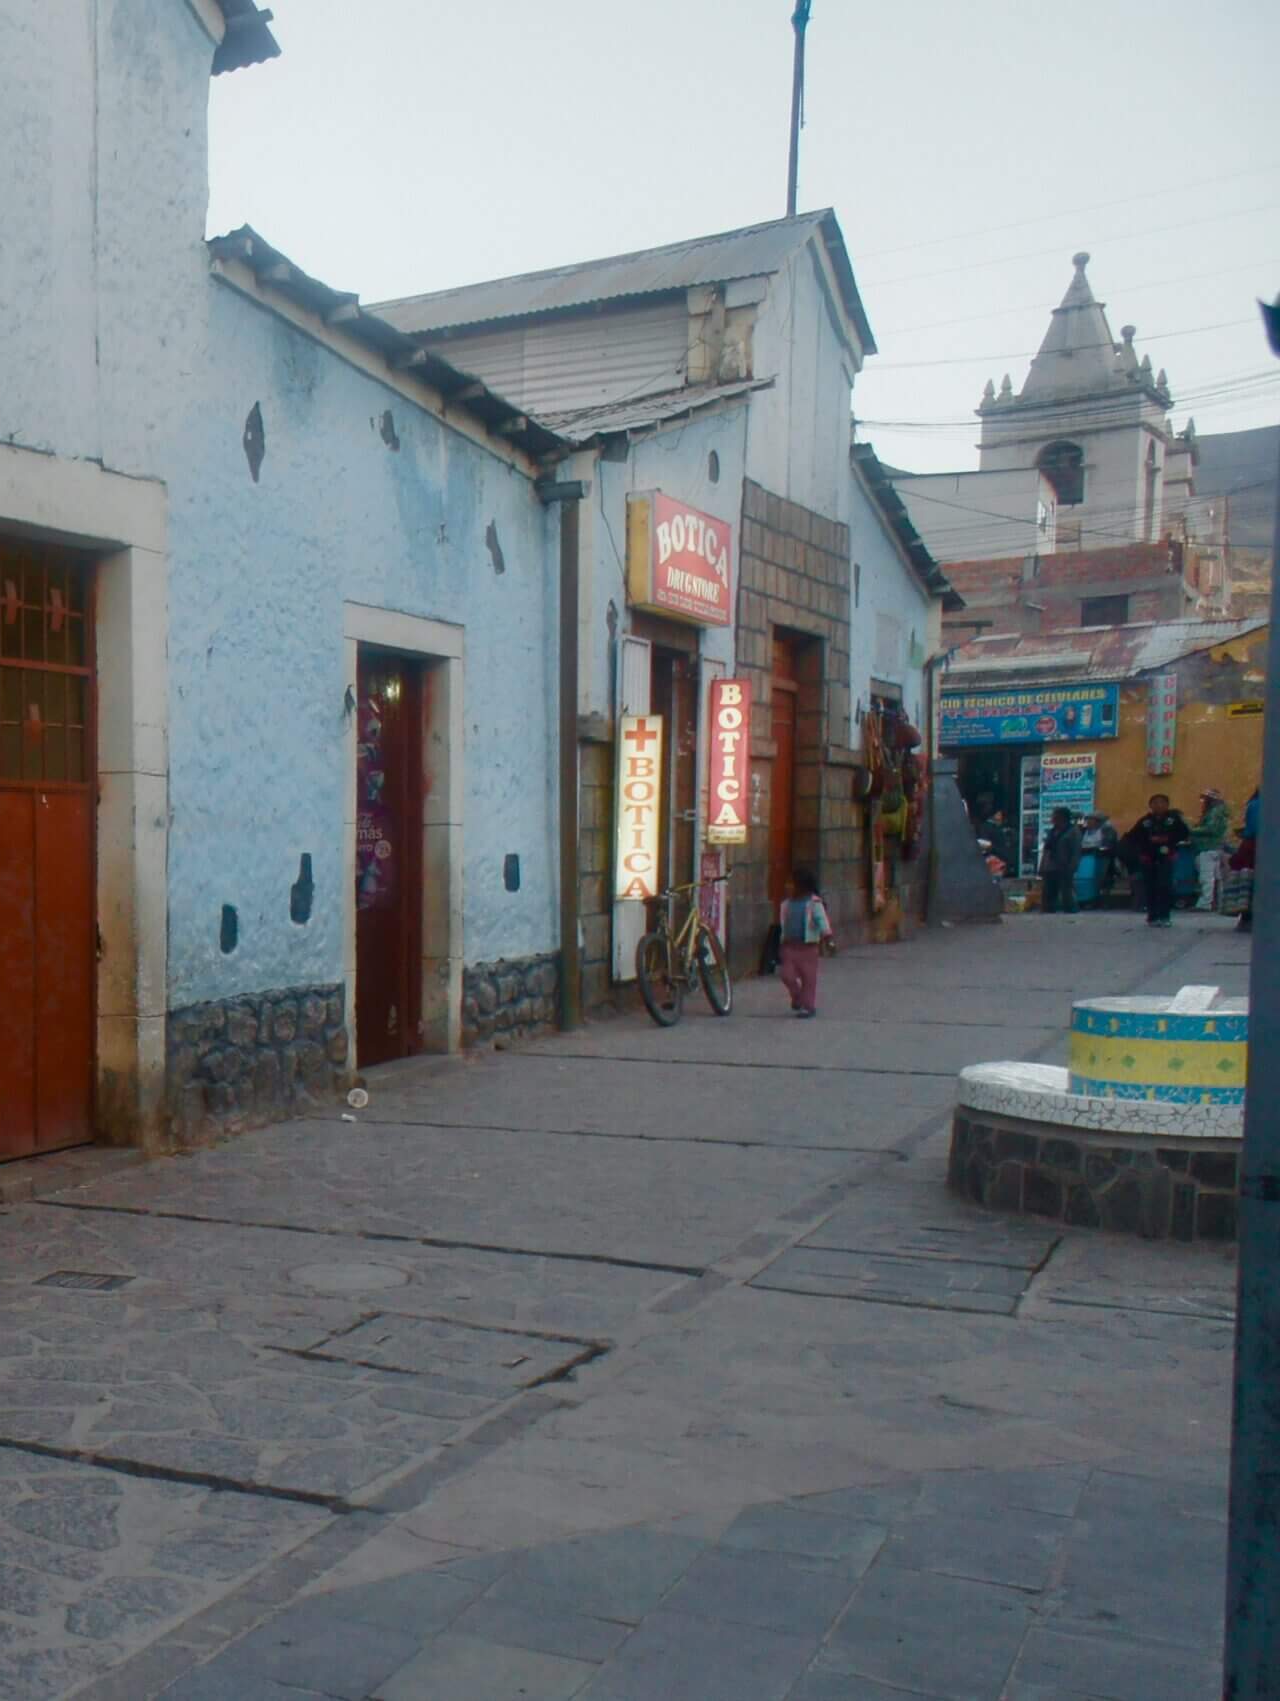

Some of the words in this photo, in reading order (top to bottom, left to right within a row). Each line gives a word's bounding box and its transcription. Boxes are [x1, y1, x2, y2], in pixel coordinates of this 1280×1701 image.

[656, 513, 729, 590] BOTICA
[714, 684, 742, 826] BOTICA
[1042, 755, 1093, 766] CELULARES
[623, 756, 655, 897] BOTICA
